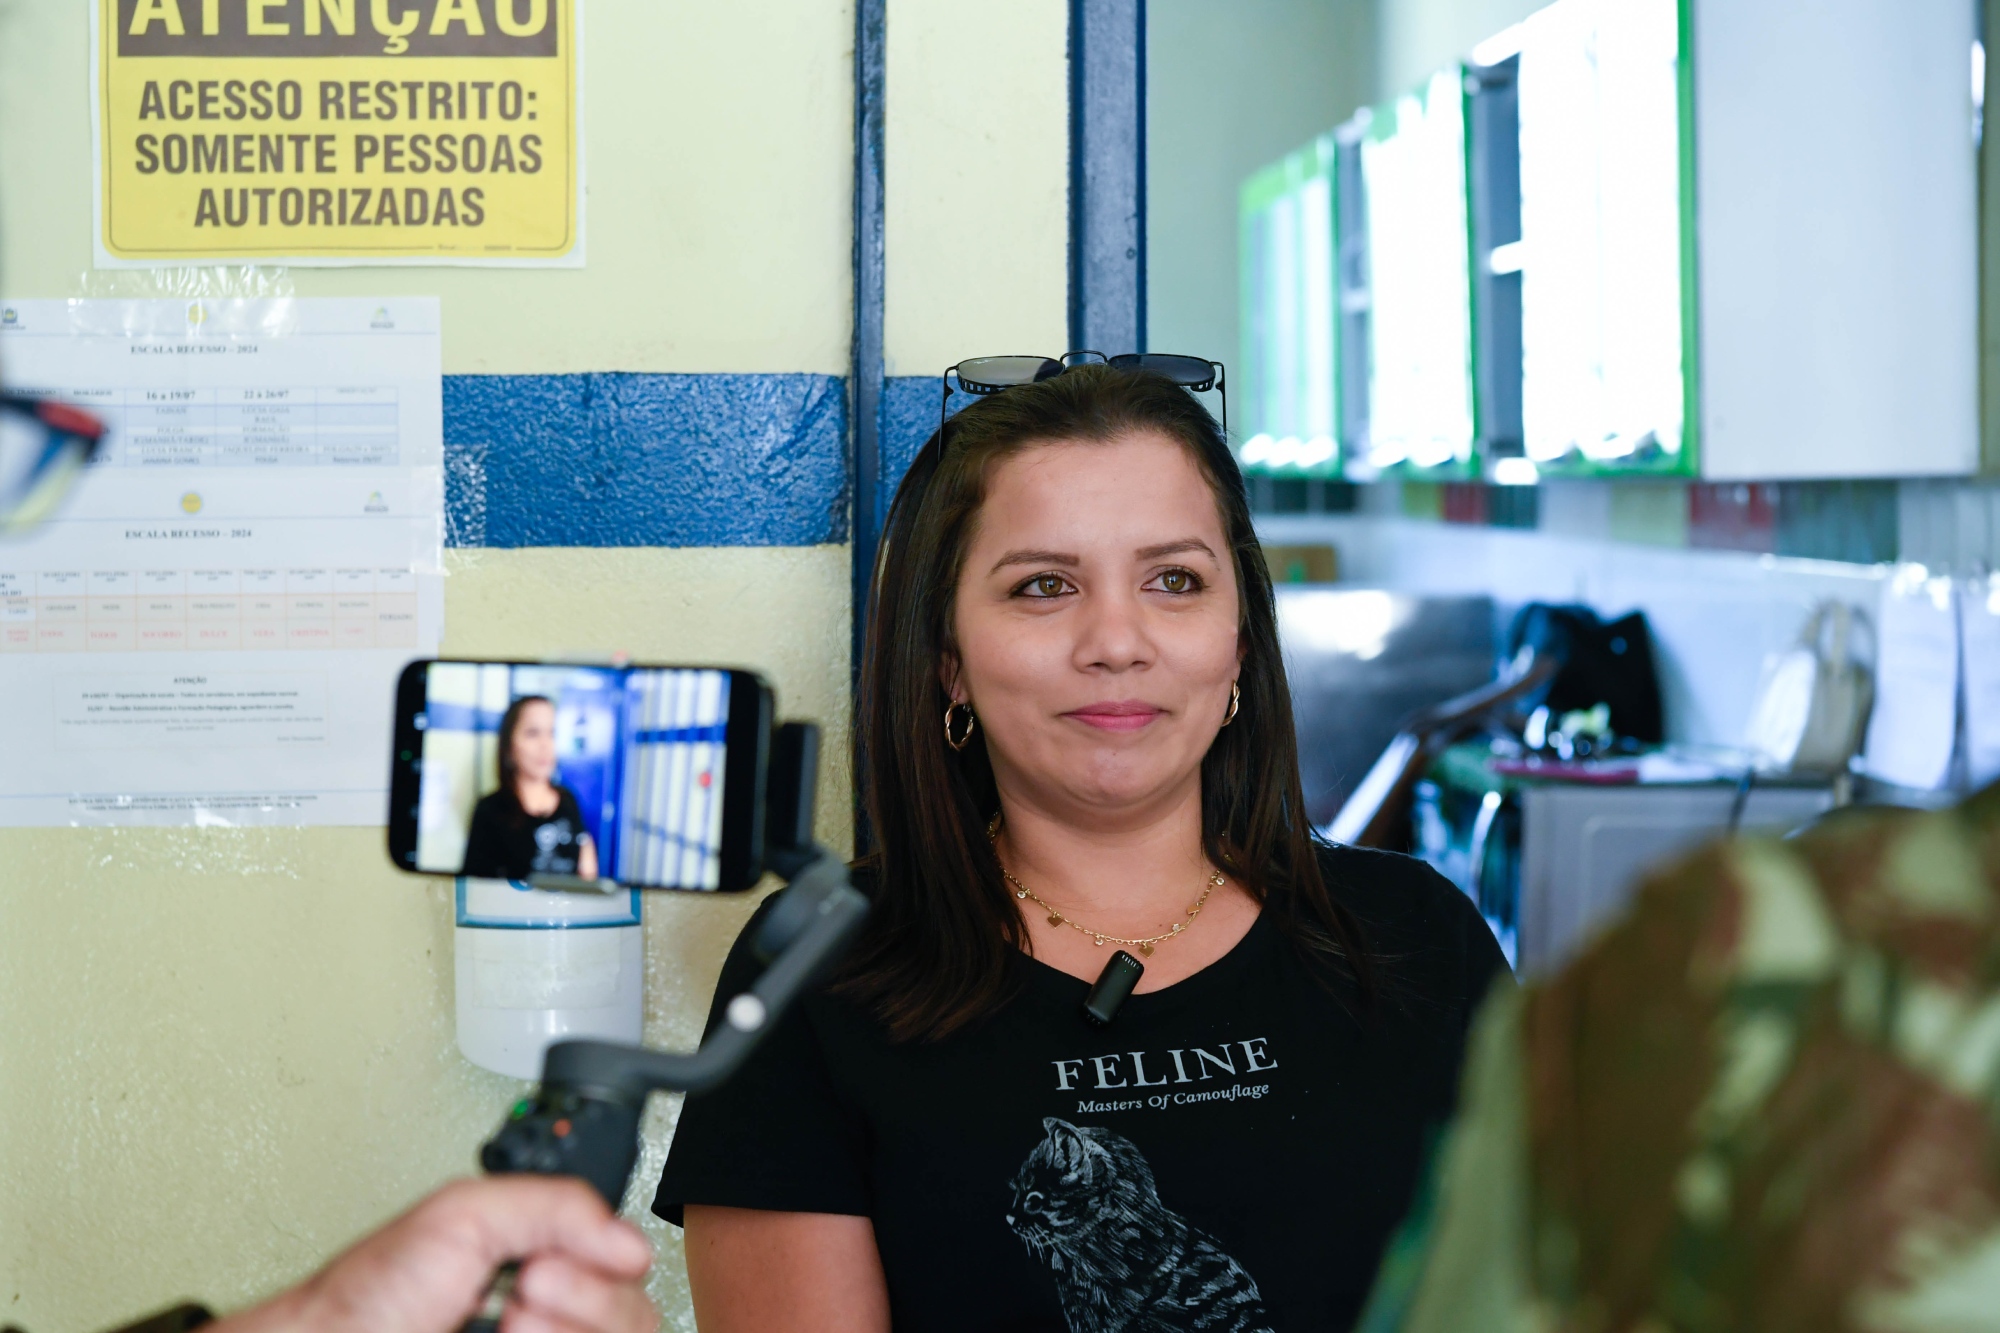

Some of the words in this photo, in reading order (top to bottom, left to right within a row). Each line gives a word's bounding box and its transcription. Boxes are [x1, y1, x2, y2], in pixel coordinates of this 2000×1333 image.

[138, 80, 302, 121] ACESSO
[319, 80, 538, 120] RESTRITO:
[135, 133, 337, 174] SOMENTE
[354, 133, 543, 174] PESSOAS
[194, 187, 486, 228] AUTORIZADAS
[130, 345, 174, 355] ESCALA
[125, 529, 168, 540] ESCALA
[170, 528, 221, 539] RECESSO
[1051, 1037, 1278, 1091] FELINE
[1076, 1099, 1143, 1113] Masters
[1147, 1093, 1171, 1110] Of
[1173, 1083, 1270, 1105] Camouflage
